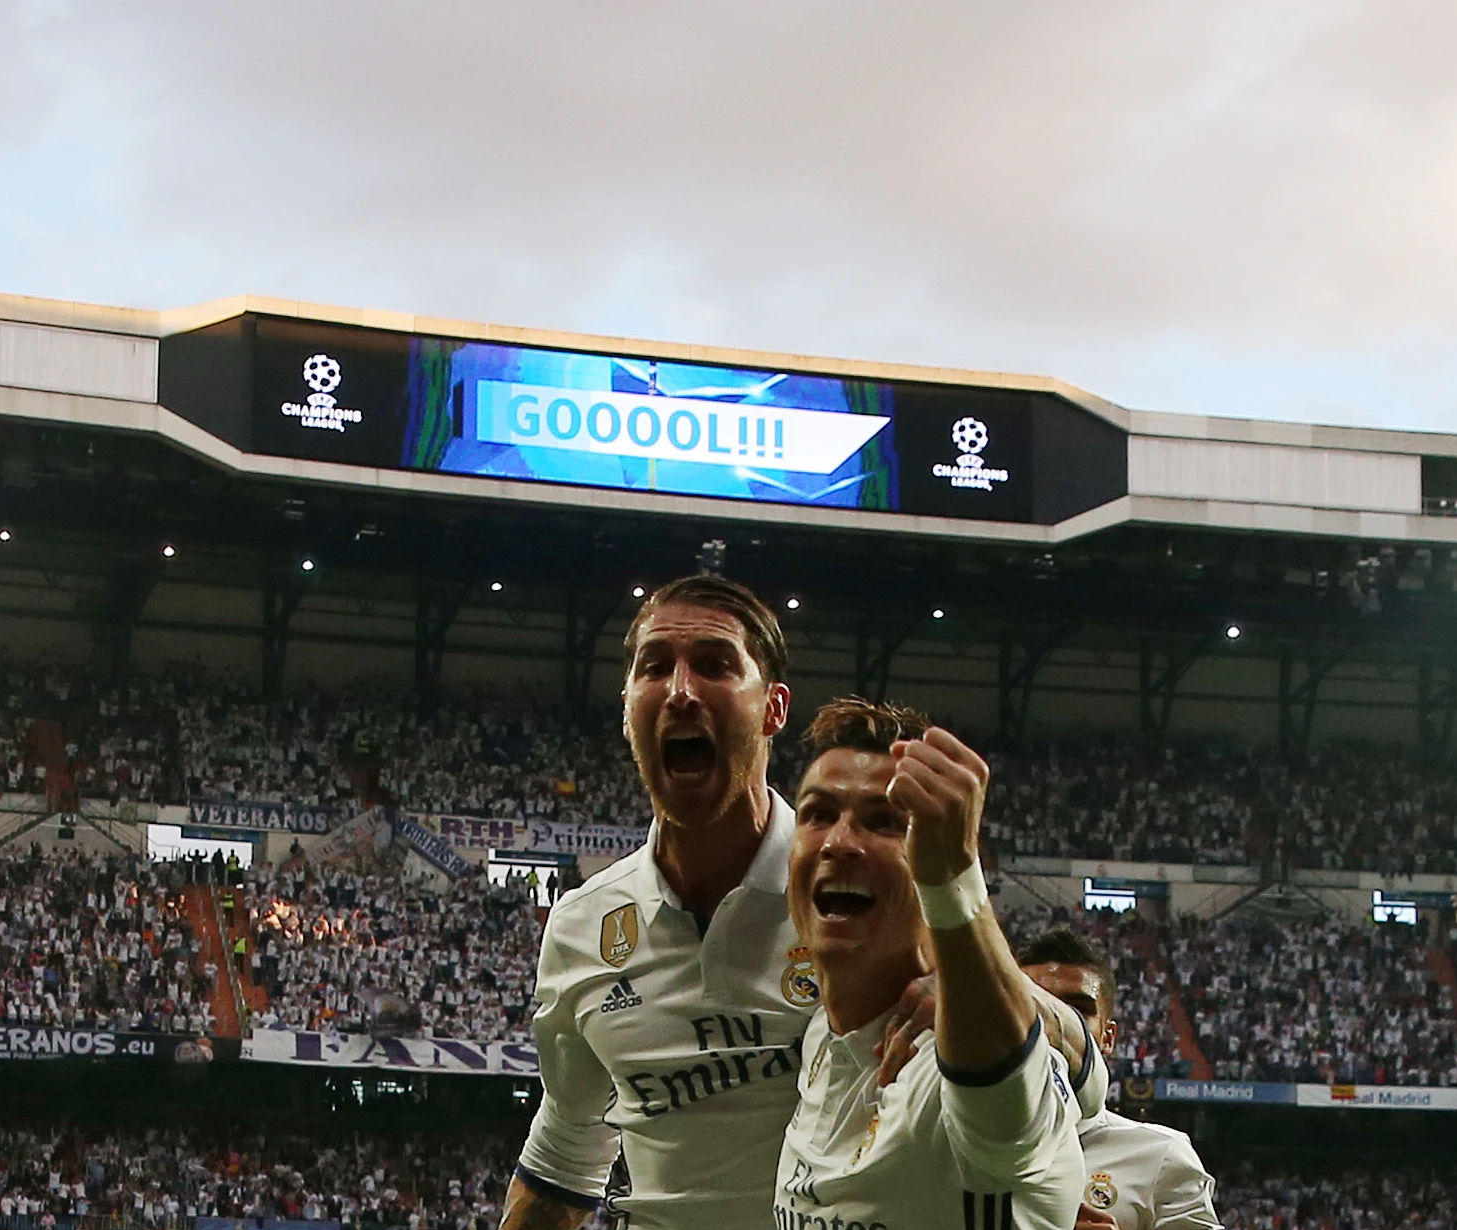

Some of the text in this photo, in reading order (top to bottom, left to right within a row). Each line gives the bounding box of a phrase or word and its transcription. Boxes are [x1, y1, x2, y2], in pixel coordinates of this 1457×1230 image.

[281, 402, 363, 423] CHAMPIONS
[507, 395, 784, 459] GOOOOL!!!
[932, 463, 1009, 482] CHAMPIONS
[193, 803, 328, 832] VETERANOS
[610, 944, 631, 956] FIFA
[600, 994, 643, 1013] adidas
[691, 1012, 764, 1051] Fly
[121, 1039, 155, 1056] .eu
[1166, 1082, 1253, 1100] Real Madrid
[1345, 1091, 1431, 1106] eal Madrid
